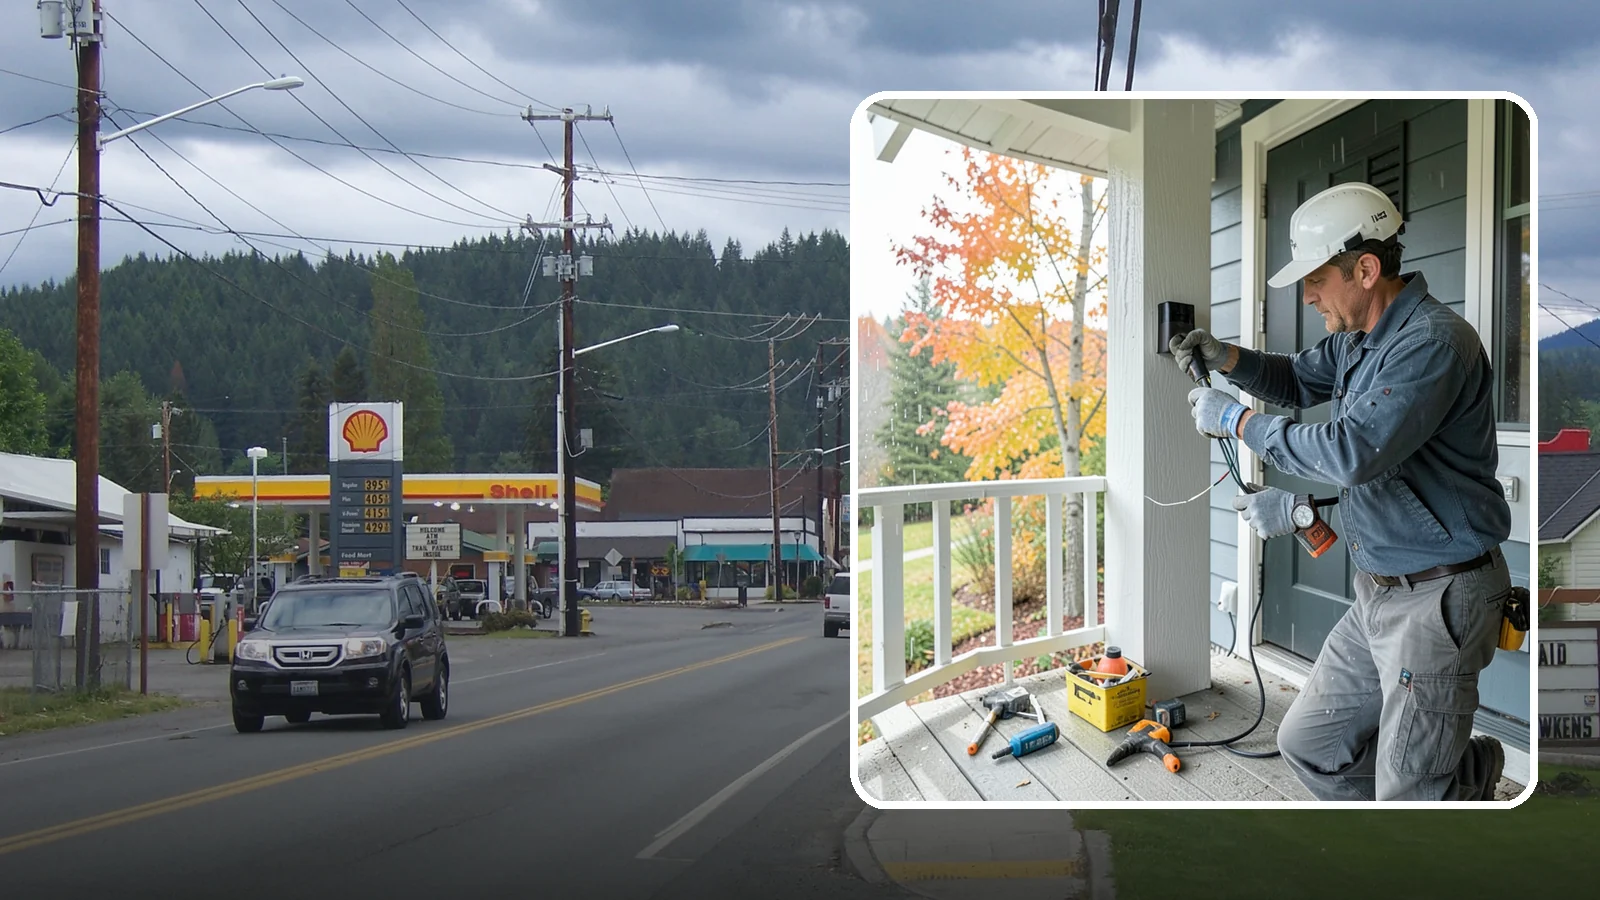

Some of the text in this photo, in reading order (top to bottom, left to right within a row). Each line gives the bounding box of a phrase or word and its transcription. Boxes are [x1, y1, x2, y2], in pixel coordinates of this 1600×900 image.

[366, 480, 383, 490] 395
[490, 484, 547, 499] Shell
[366, 494, 383, 504] 405
[366, 508, 383, 518] 415
[366, 522, 383, 533] 429
